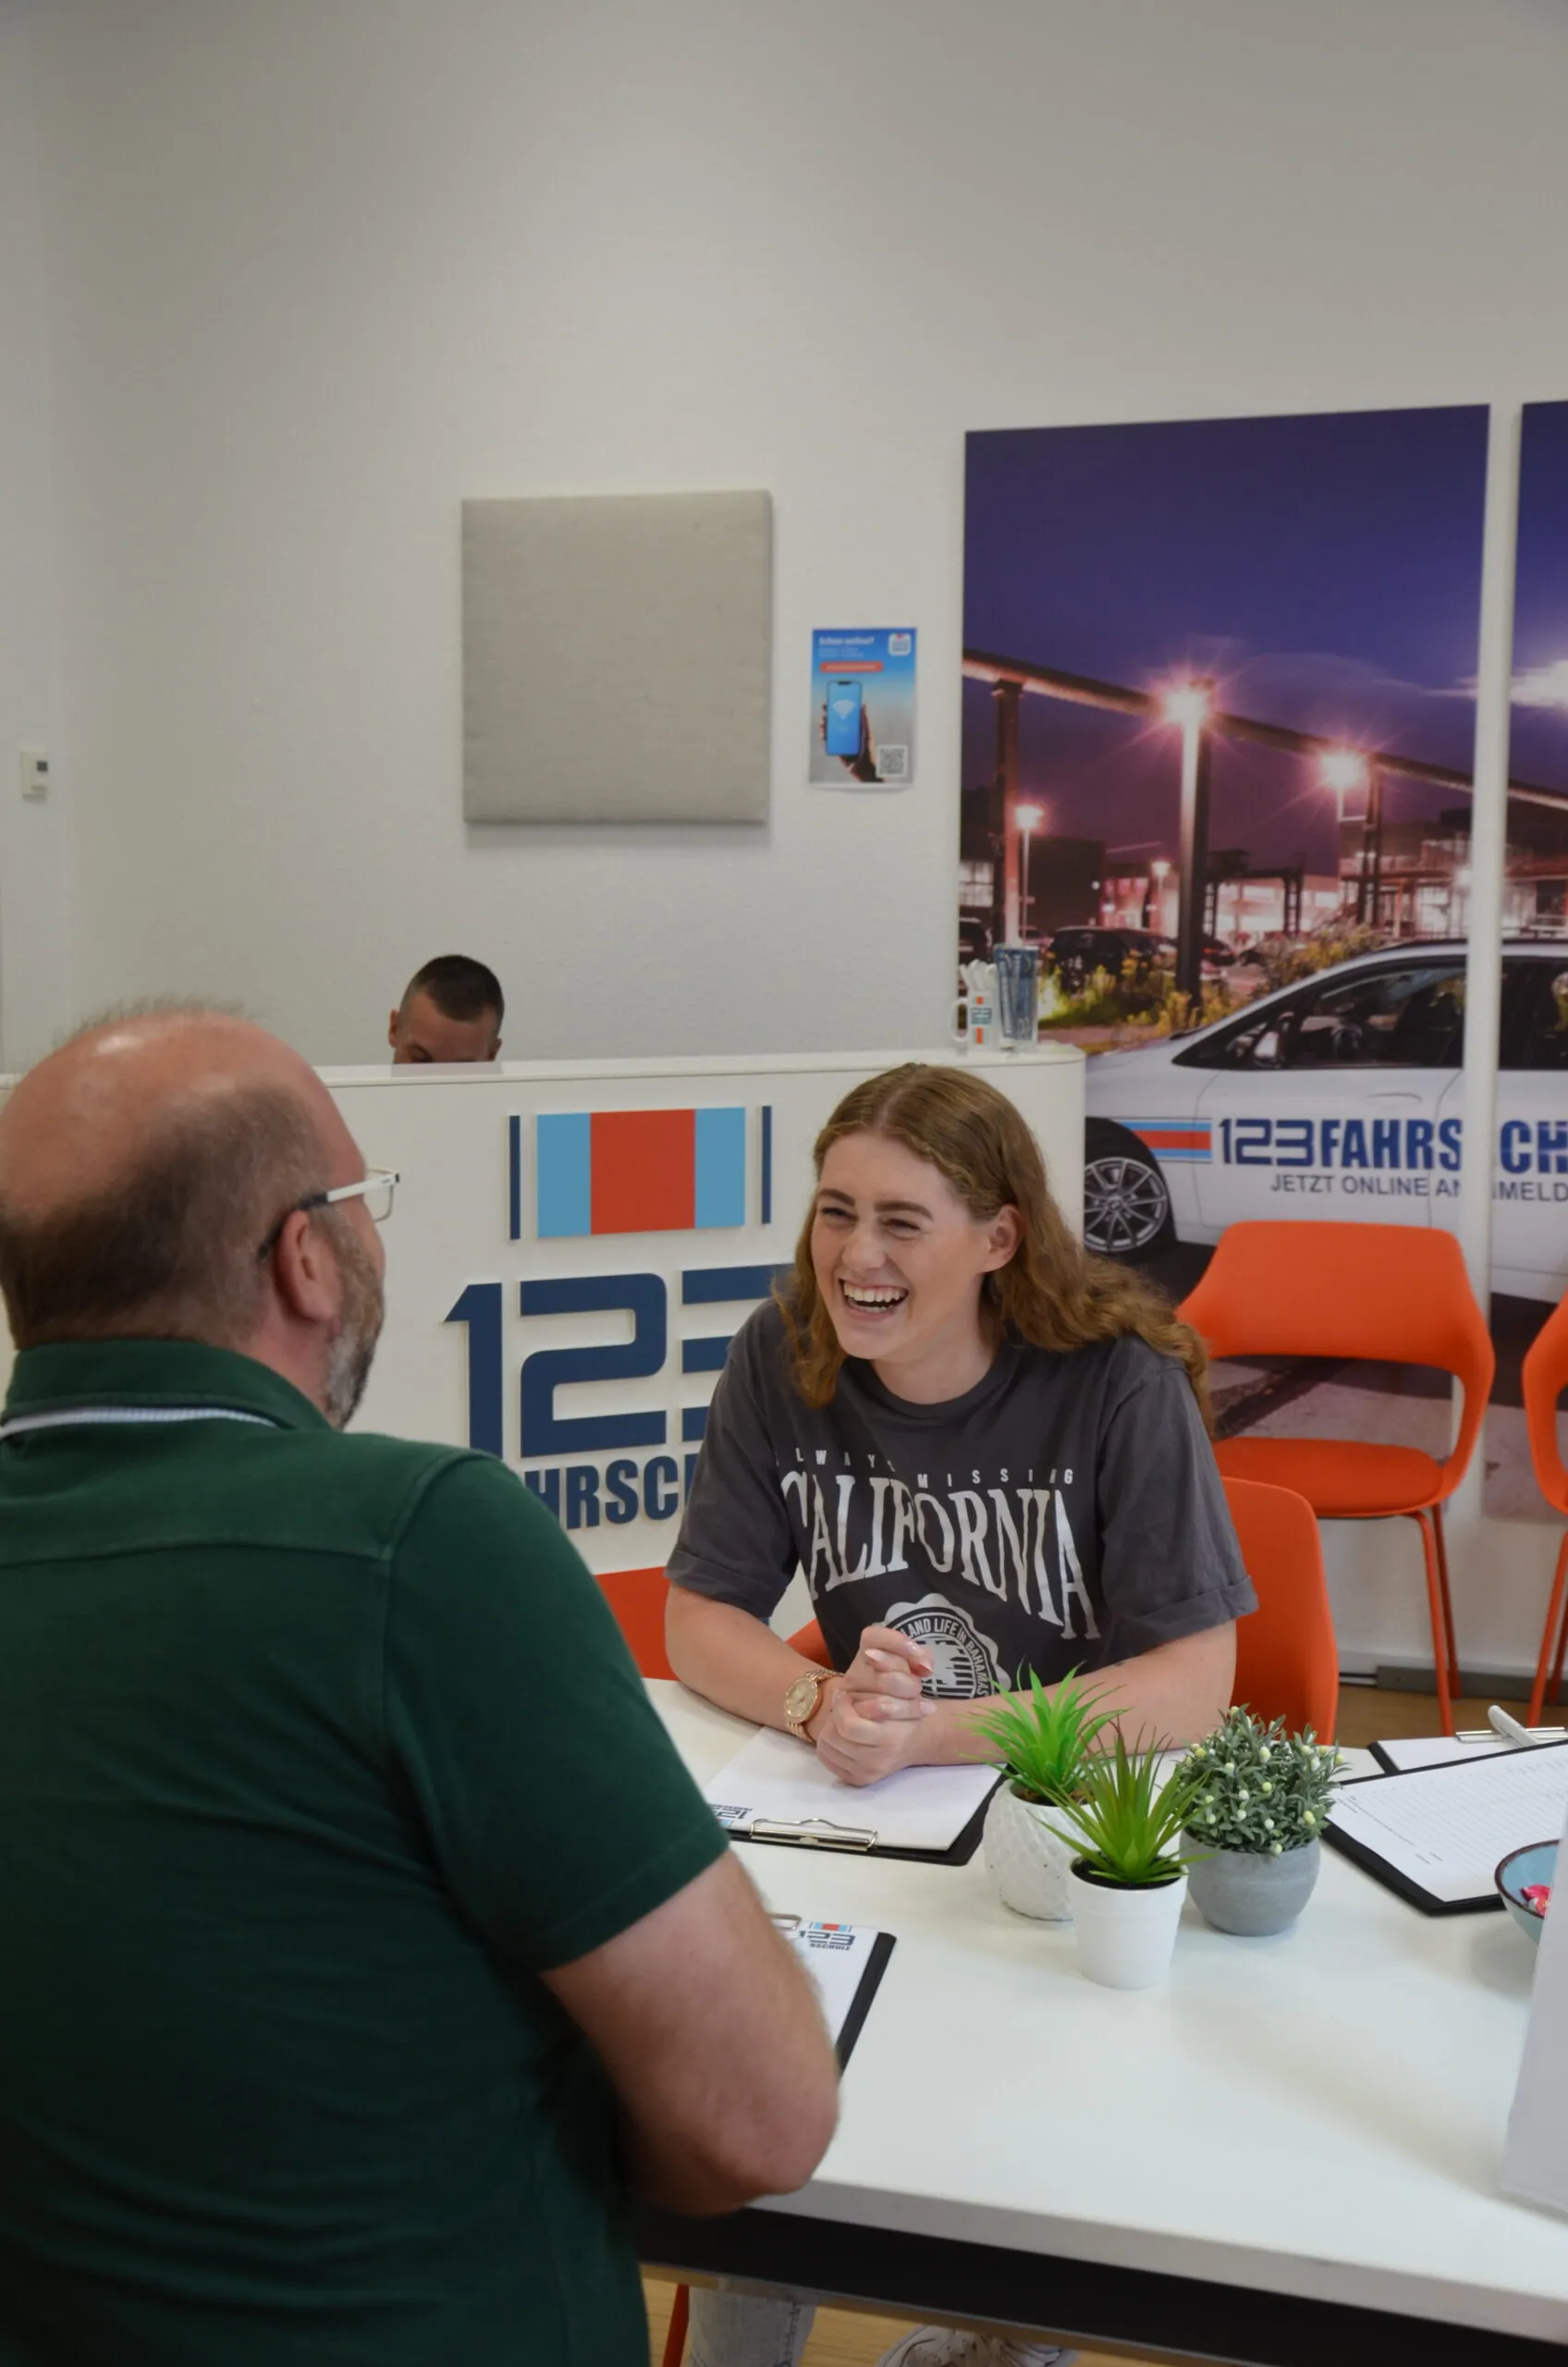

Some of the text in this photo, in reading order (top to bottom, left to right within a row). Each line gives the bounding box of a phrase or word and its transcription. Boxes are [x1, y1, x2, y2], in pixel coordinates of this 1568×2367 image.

[1270, 1173, 1334, 1193] JETZT
[1342, 1175, 1429, 1196] ONLINE
[934, 1617, 959, 1636] LIFE
[956, 1627, 967, 1643] IN
[964, 1639, 990, 1696] BAHAMAS
